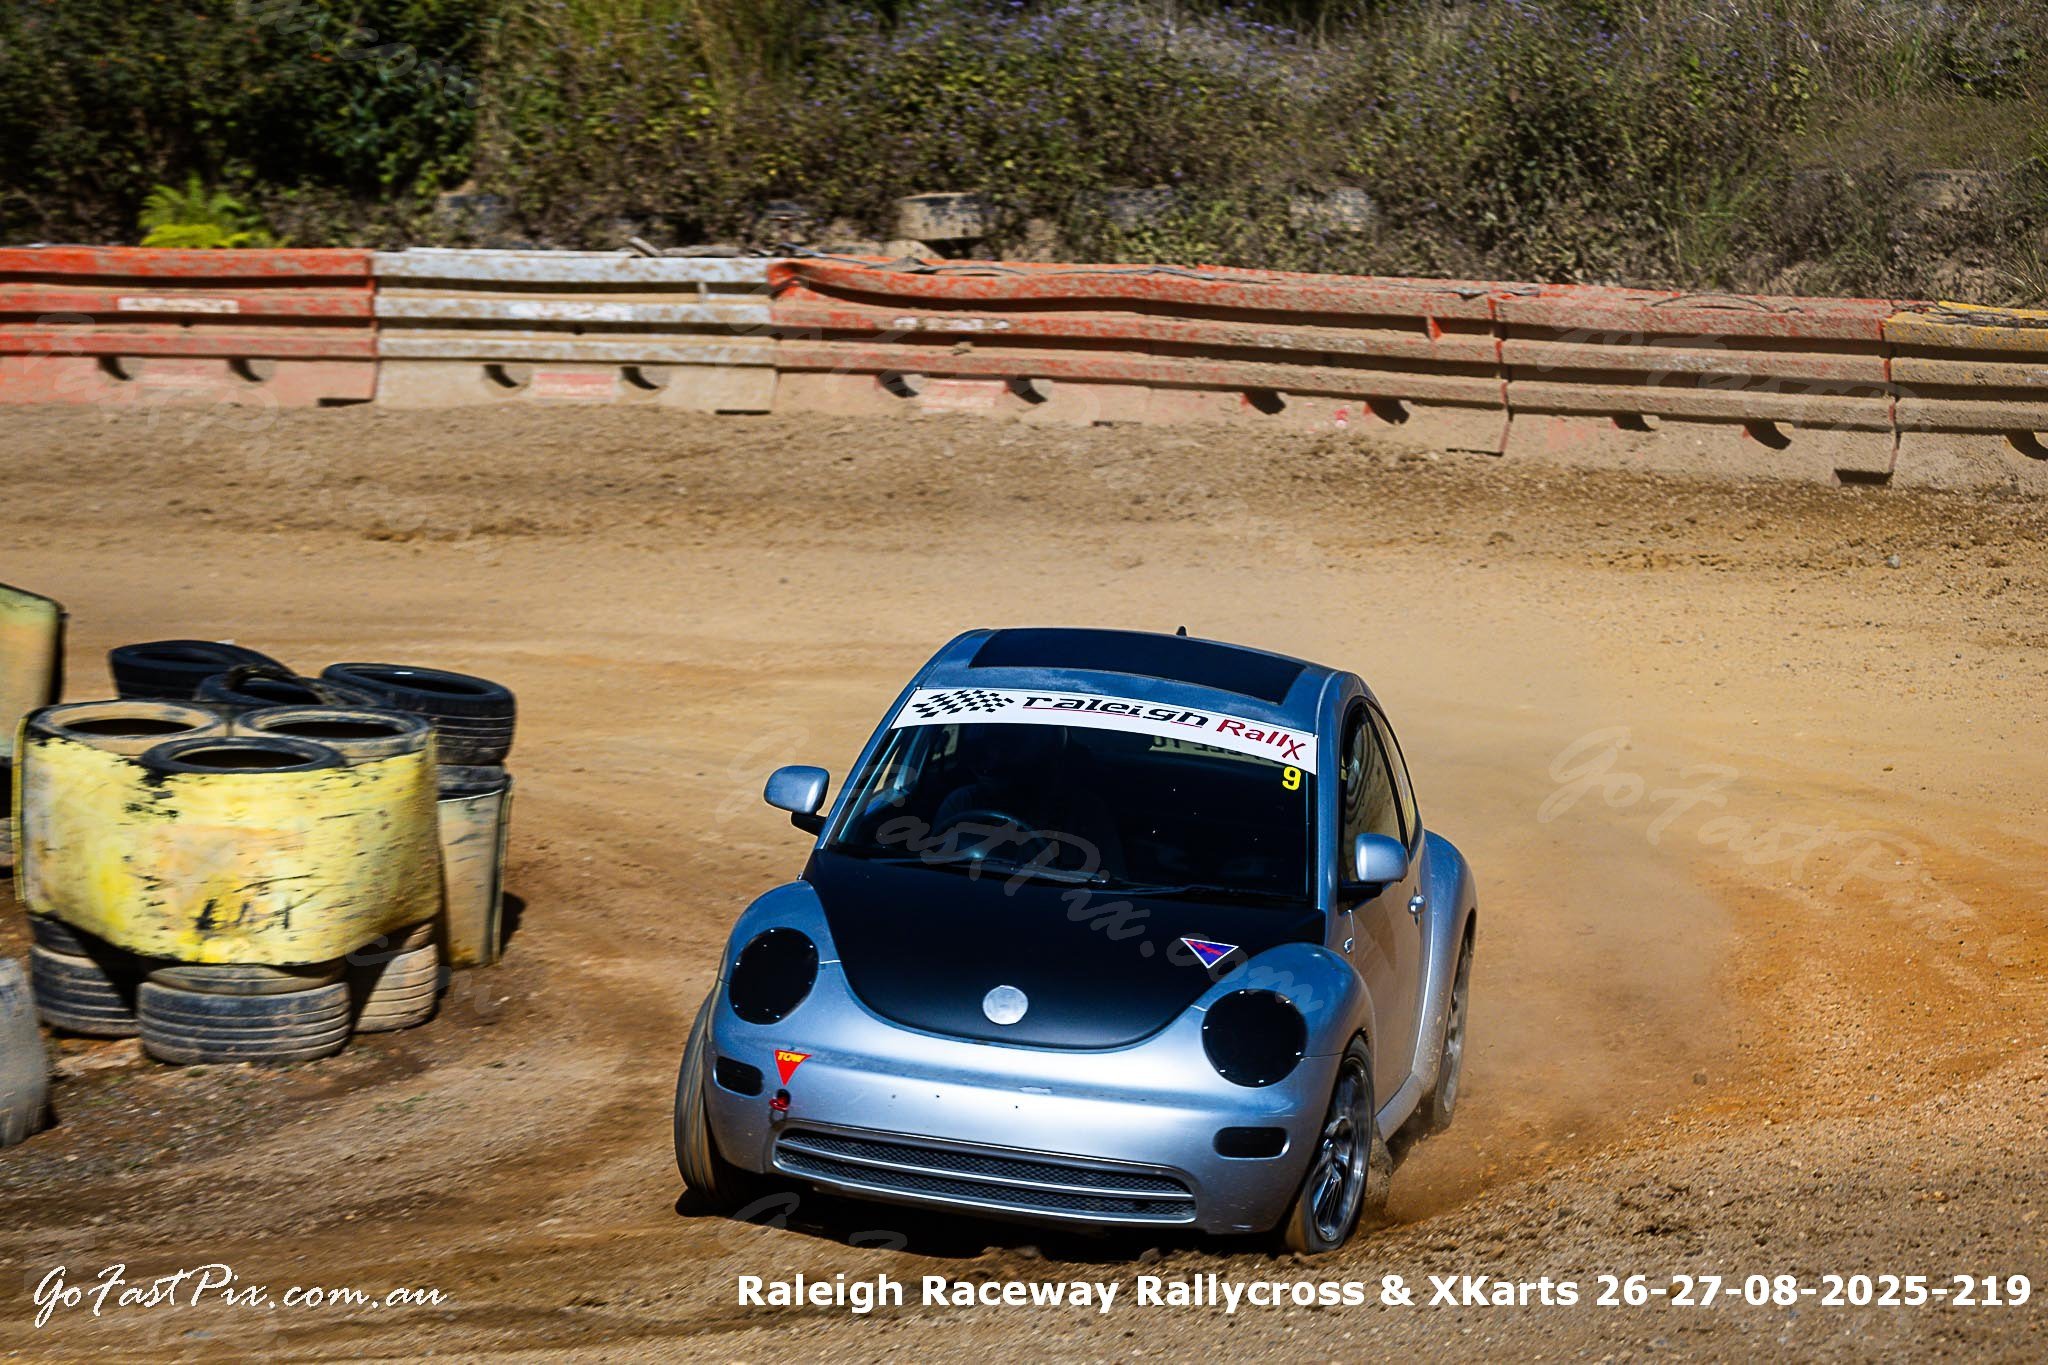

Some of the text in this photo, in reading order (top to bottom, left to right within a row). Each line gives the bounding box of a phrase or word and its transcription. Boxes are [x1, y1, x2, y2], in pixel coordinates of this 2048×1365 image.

[1022, 696, 1209, 727] raleigh
[1282, 766, 1302, 791] 9
[777, 1051, 806, 1063] TOW
